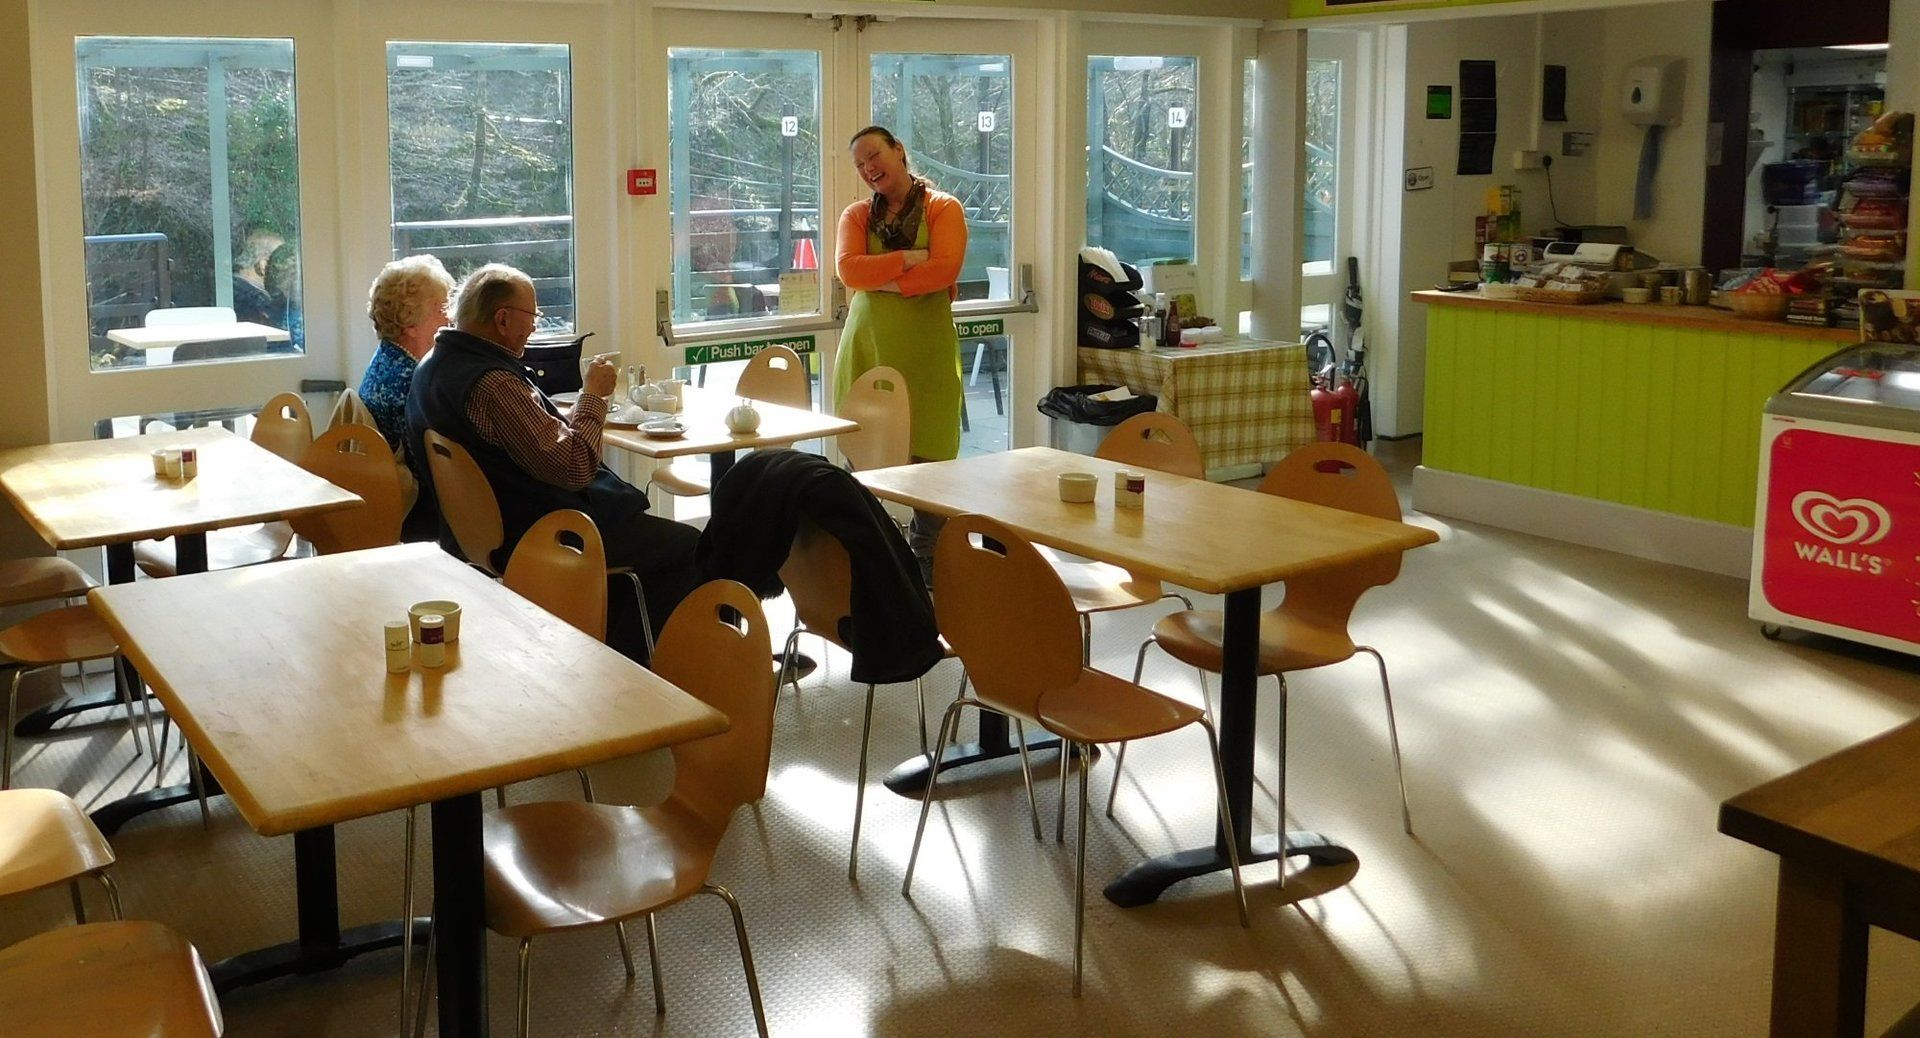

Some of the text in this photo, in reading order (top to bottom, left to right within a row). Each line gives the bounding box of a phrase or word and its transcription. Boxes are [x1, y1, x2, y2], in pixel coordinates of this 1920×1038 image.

[981, 115, 992, 128] 13
[1172, 111, 1183, 125] 14
[785, 120, 796, 133] 12
[958, 323, 999, 336] to open
[711, 344, 741, 359] Push
[744, 343, 764, 356] bar
[1794, 541, 1882, 575] WALL'S
